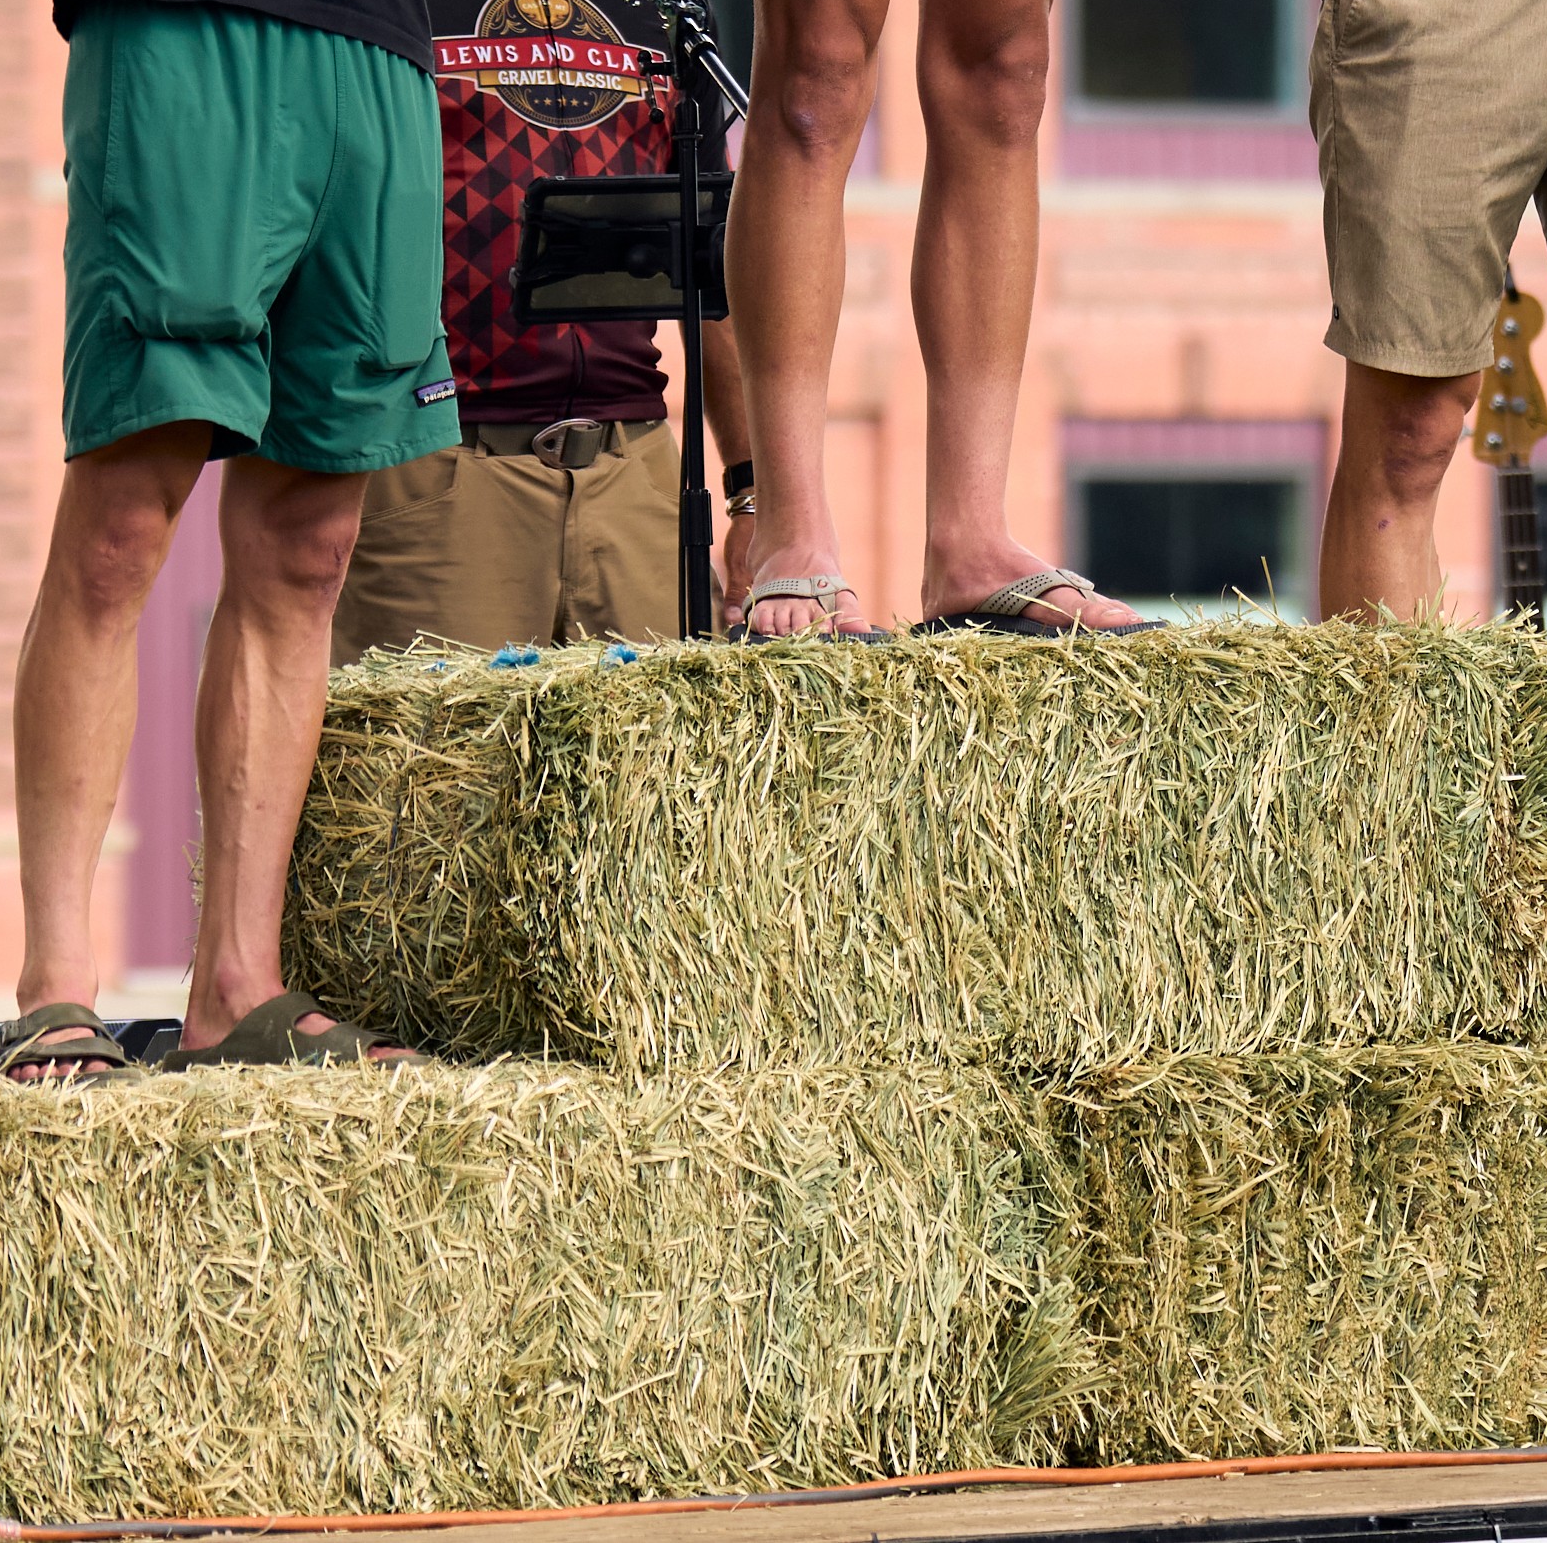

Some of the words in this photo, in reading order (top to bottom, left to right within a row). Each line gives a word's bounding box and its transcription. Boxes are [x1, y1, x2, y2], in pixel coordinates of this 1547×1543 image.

[441, 45, 518, 66] LEWIS
[531, 43, 575, 65] AND
[498, 69, 556, 86] GRAVEL
[559, 69, 622, 90] CLASSIC
